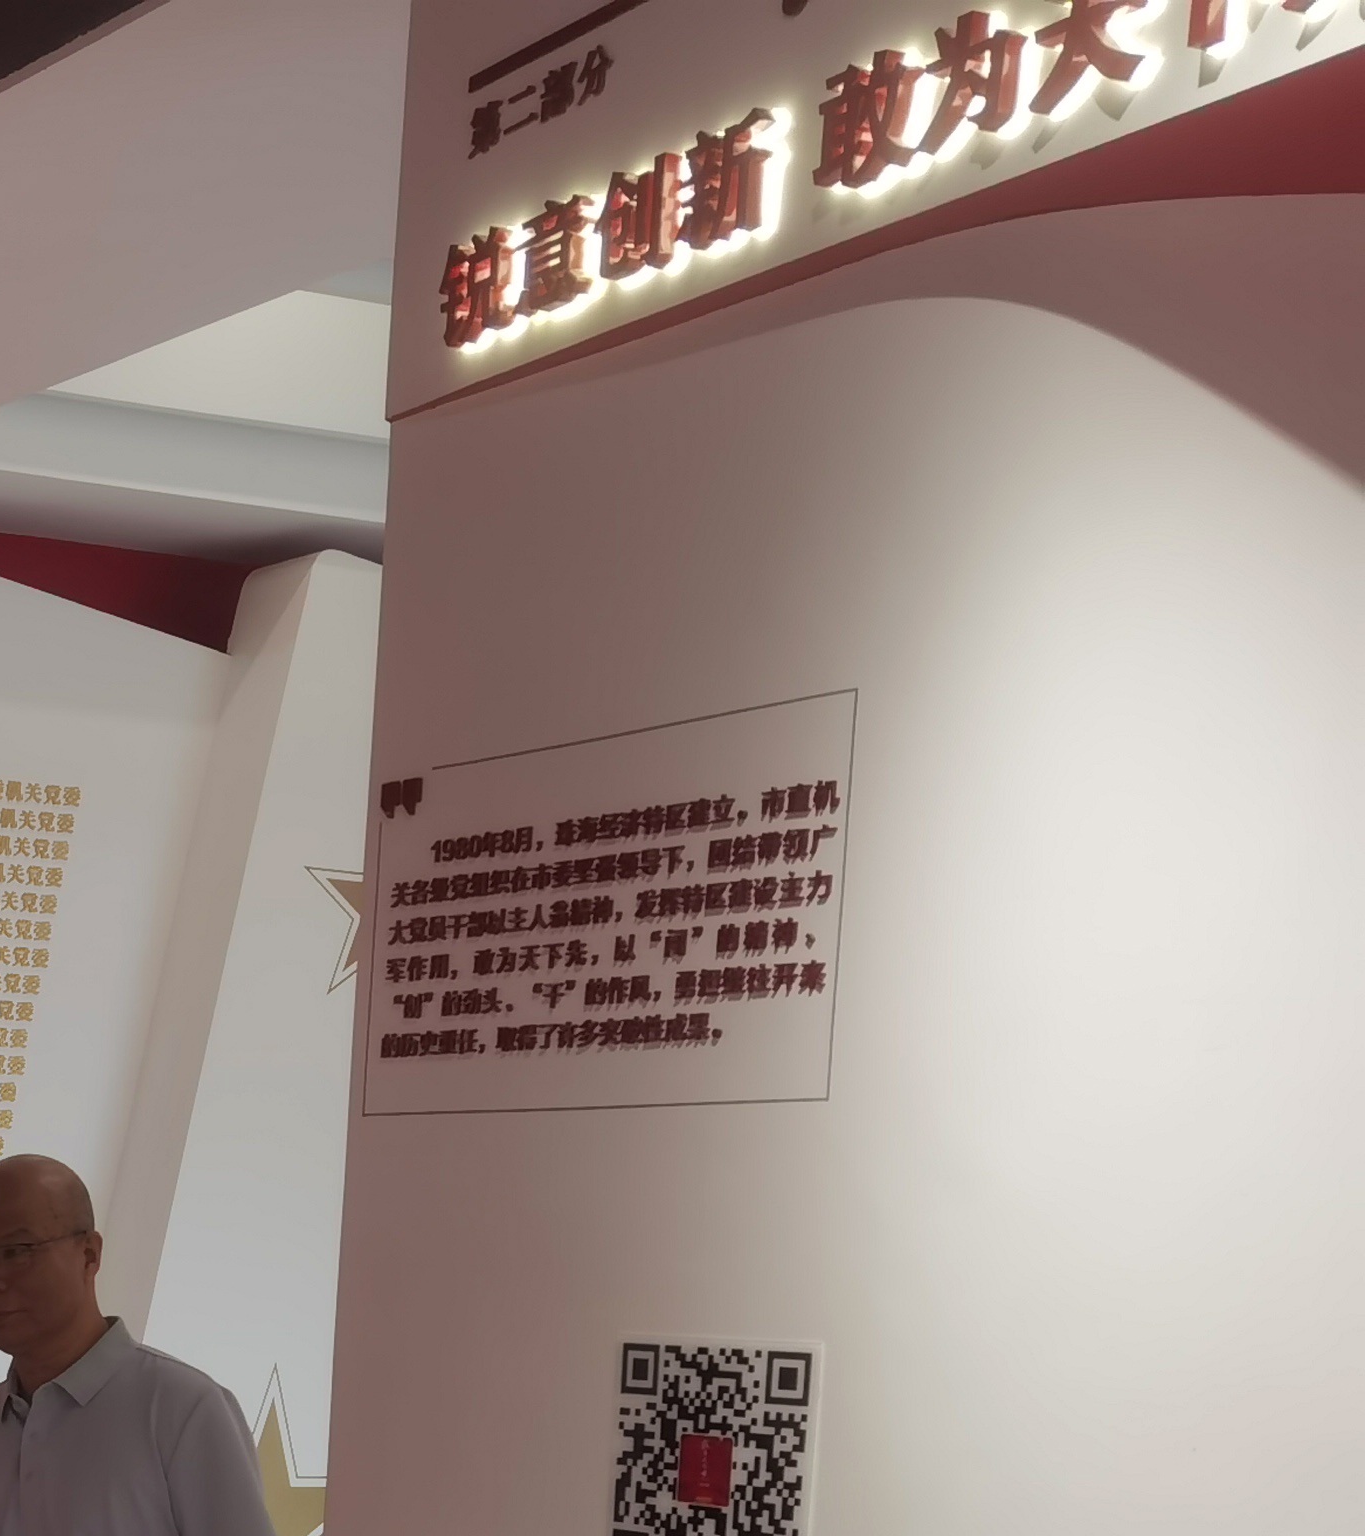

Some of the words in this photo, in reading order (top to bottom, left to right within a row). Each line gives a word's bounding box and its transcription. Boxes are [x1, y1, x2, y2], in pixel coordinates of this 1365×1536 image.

[469, 44, 613, 160] 第二部分
[439, 108, 777, 348] 锐意创新
